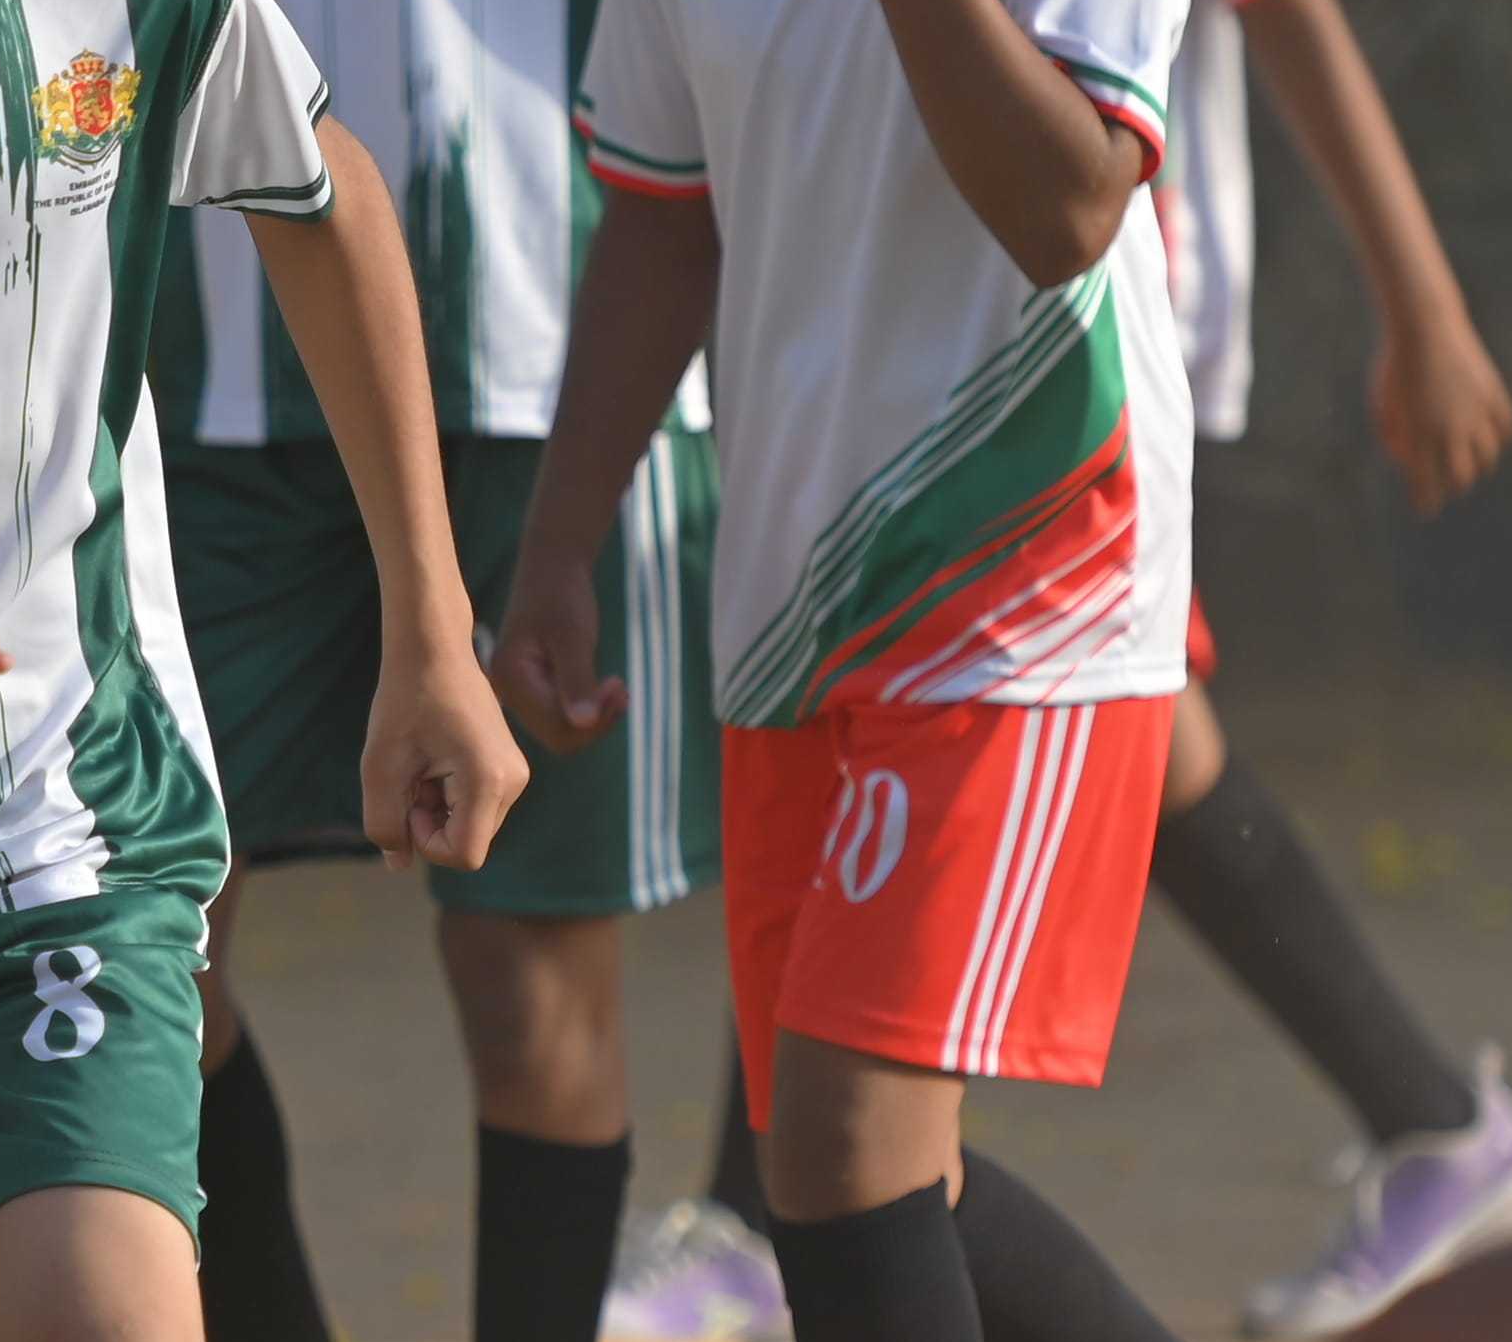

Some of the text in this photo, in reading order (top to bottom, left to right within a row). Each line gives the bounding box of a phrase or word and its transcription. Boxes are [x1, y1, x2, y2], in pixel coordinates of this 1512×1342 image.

[33, 198, 52, 209] THE
[812, 763, 910, 904] 10
[21, 945, 105, 1062] 8
